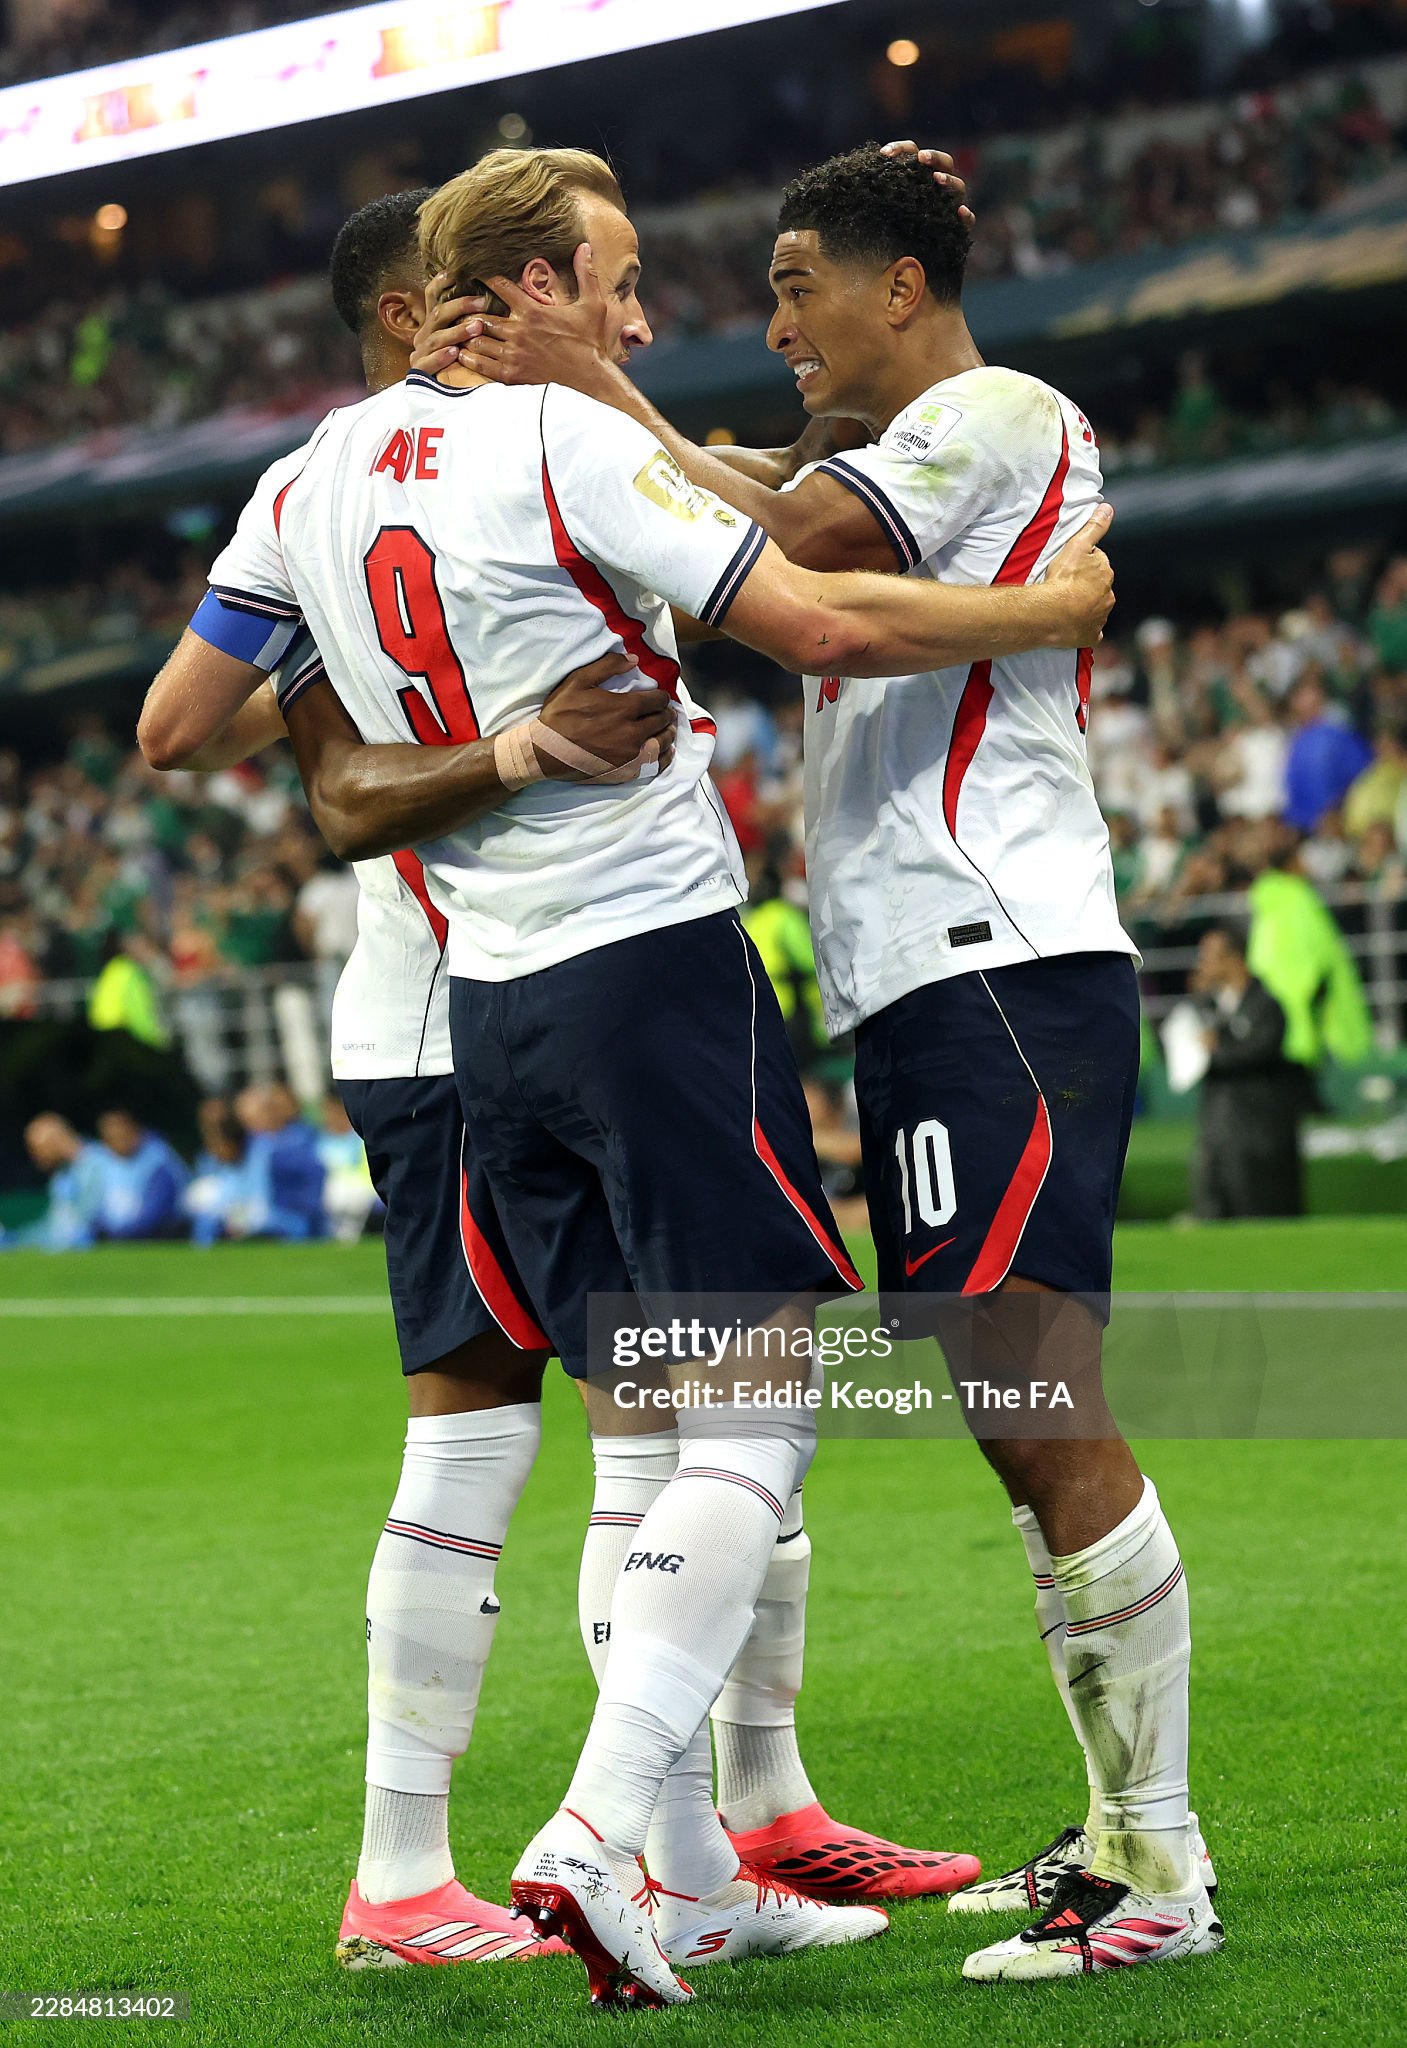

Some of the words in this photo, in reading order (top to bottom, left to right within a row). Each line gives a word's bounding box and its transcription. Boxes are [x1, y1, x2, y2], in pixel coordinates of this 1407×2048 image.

[896, 441, 911, 453] FIFA
[363, 525, 482, 746] 9
[895, 1117, 958, 1235] 10
[624, 1551, 686, 1575] ENG
[533, 1871, 560, 1879] HENRY
[559, 1857, 610, 1880] SKX
[1154, 1912, 1185, 1923] PREDATOR
